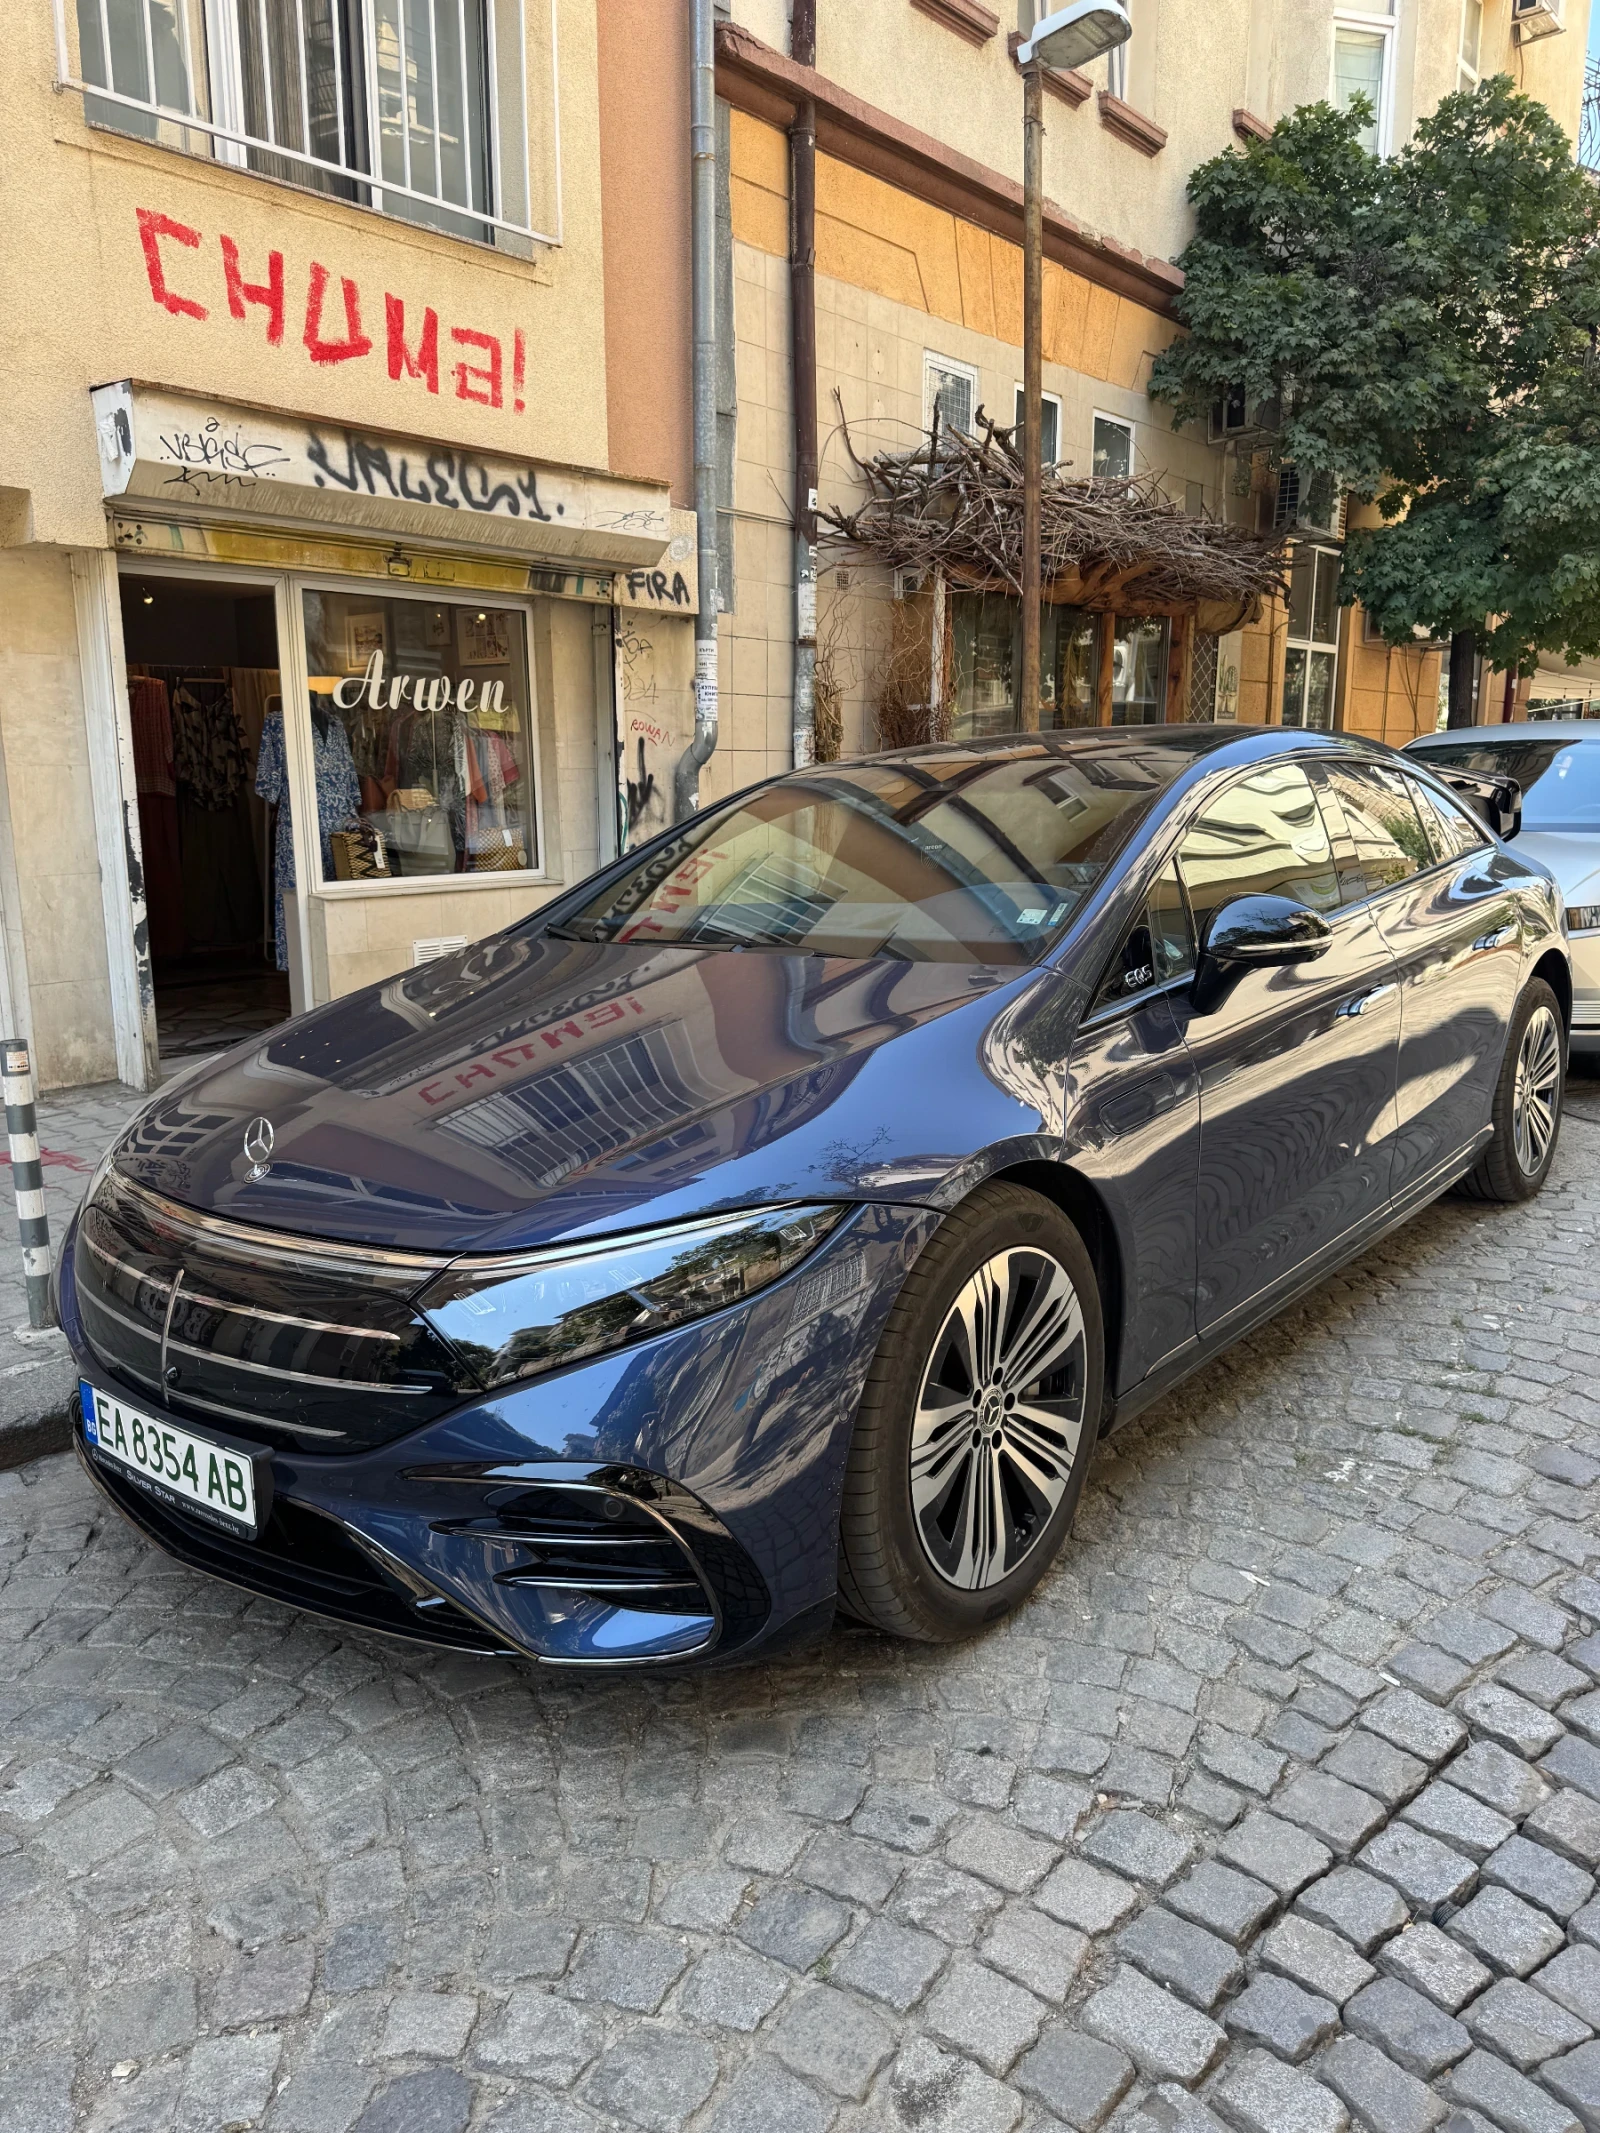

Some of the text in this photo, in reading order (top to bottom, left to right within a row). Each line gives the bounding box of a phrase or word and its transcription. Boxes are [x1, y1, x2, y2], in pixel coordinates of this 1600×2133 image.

[625, 569, 690, 606] FIRA
[332, 649, 510, 713] Arwen
[86, 1418, 97, 1436] BG
[96, 1396, 248, 1513] EA 8354 AB
[126, 1469, 153, 1492] SILVER
[154, 1485, 176, 1504] STAR
